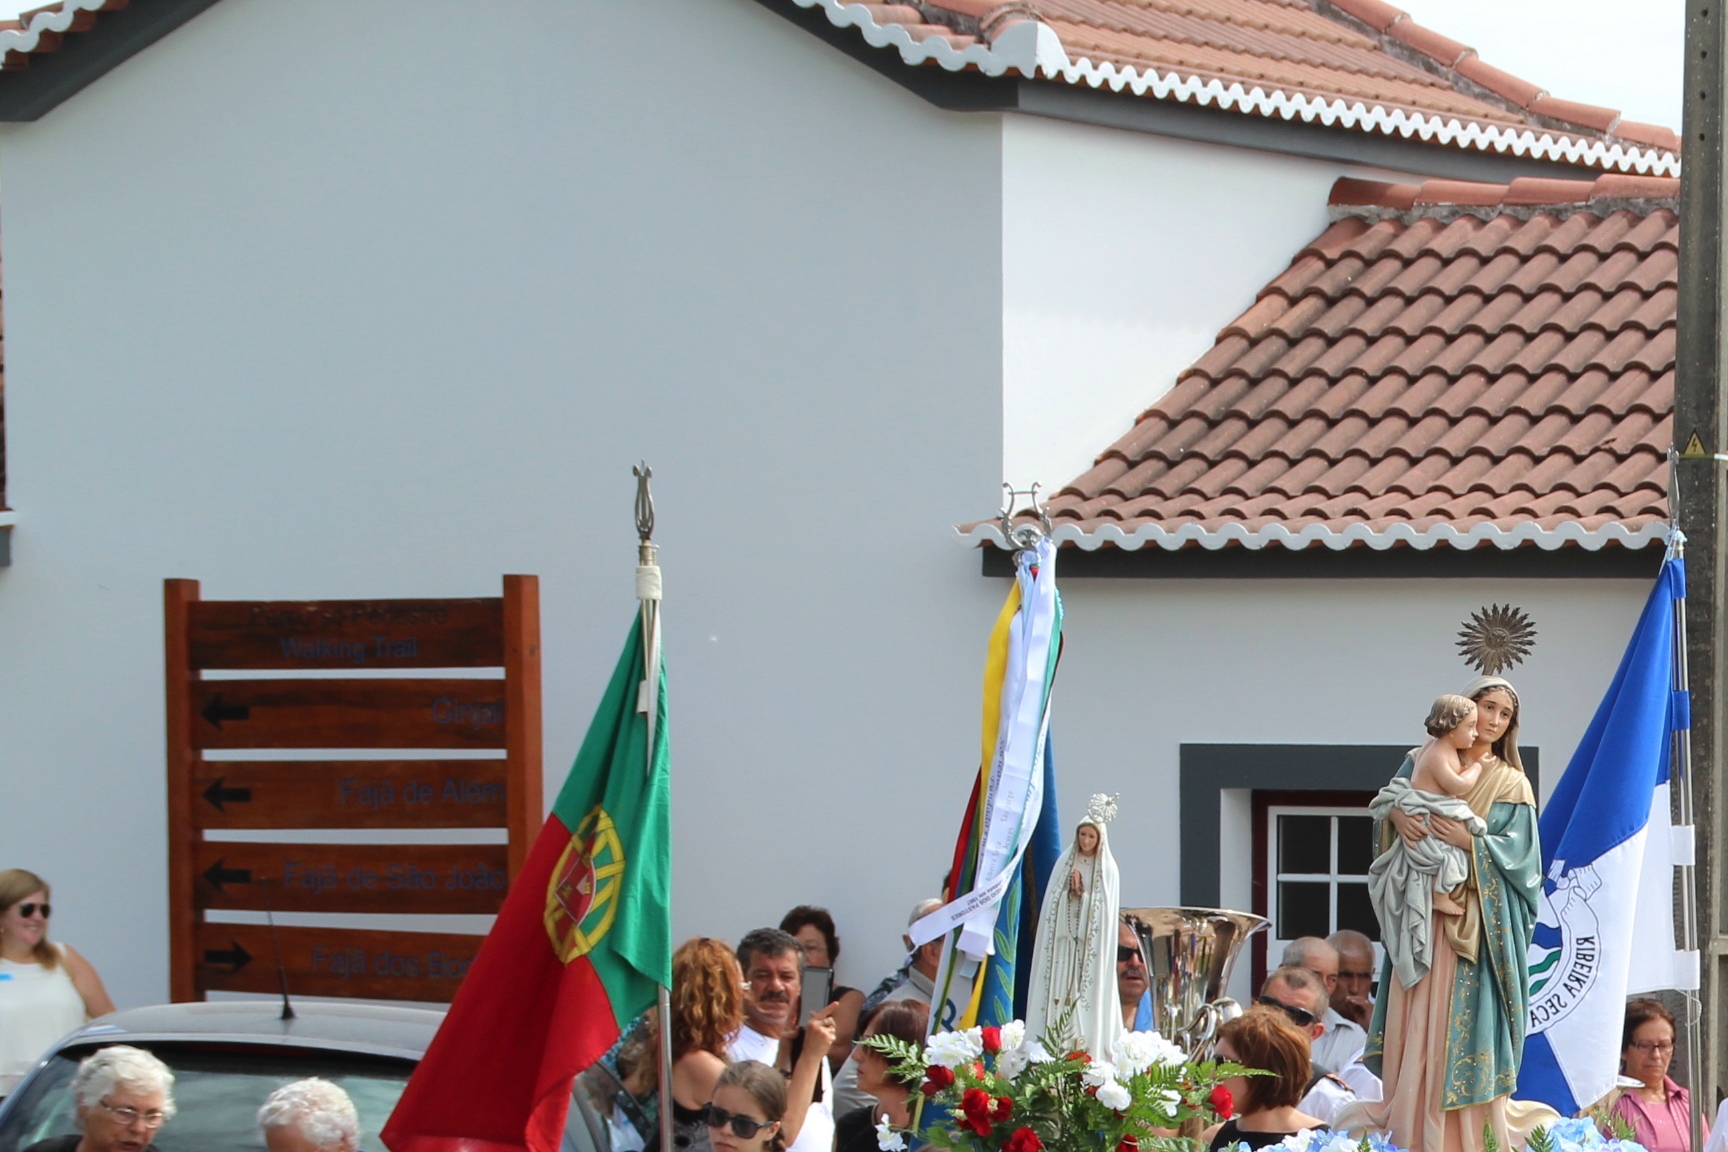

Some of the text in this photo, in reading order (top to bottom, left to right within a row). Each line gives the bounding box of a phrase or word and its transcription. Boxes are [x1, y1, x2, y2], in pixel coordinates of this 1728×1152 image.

[280, 635, 418, 663] Walking Trail
[431, 697, 504, 730] Ginjal
[402, 778, 434, 805] de
[346, 864, 379, 890] de
[386, 862, 436, 891] São
[445, 862, 507, 891] João
[951, 904, 980, 921] PASTORES
[374, 950, 420, 978] dos
